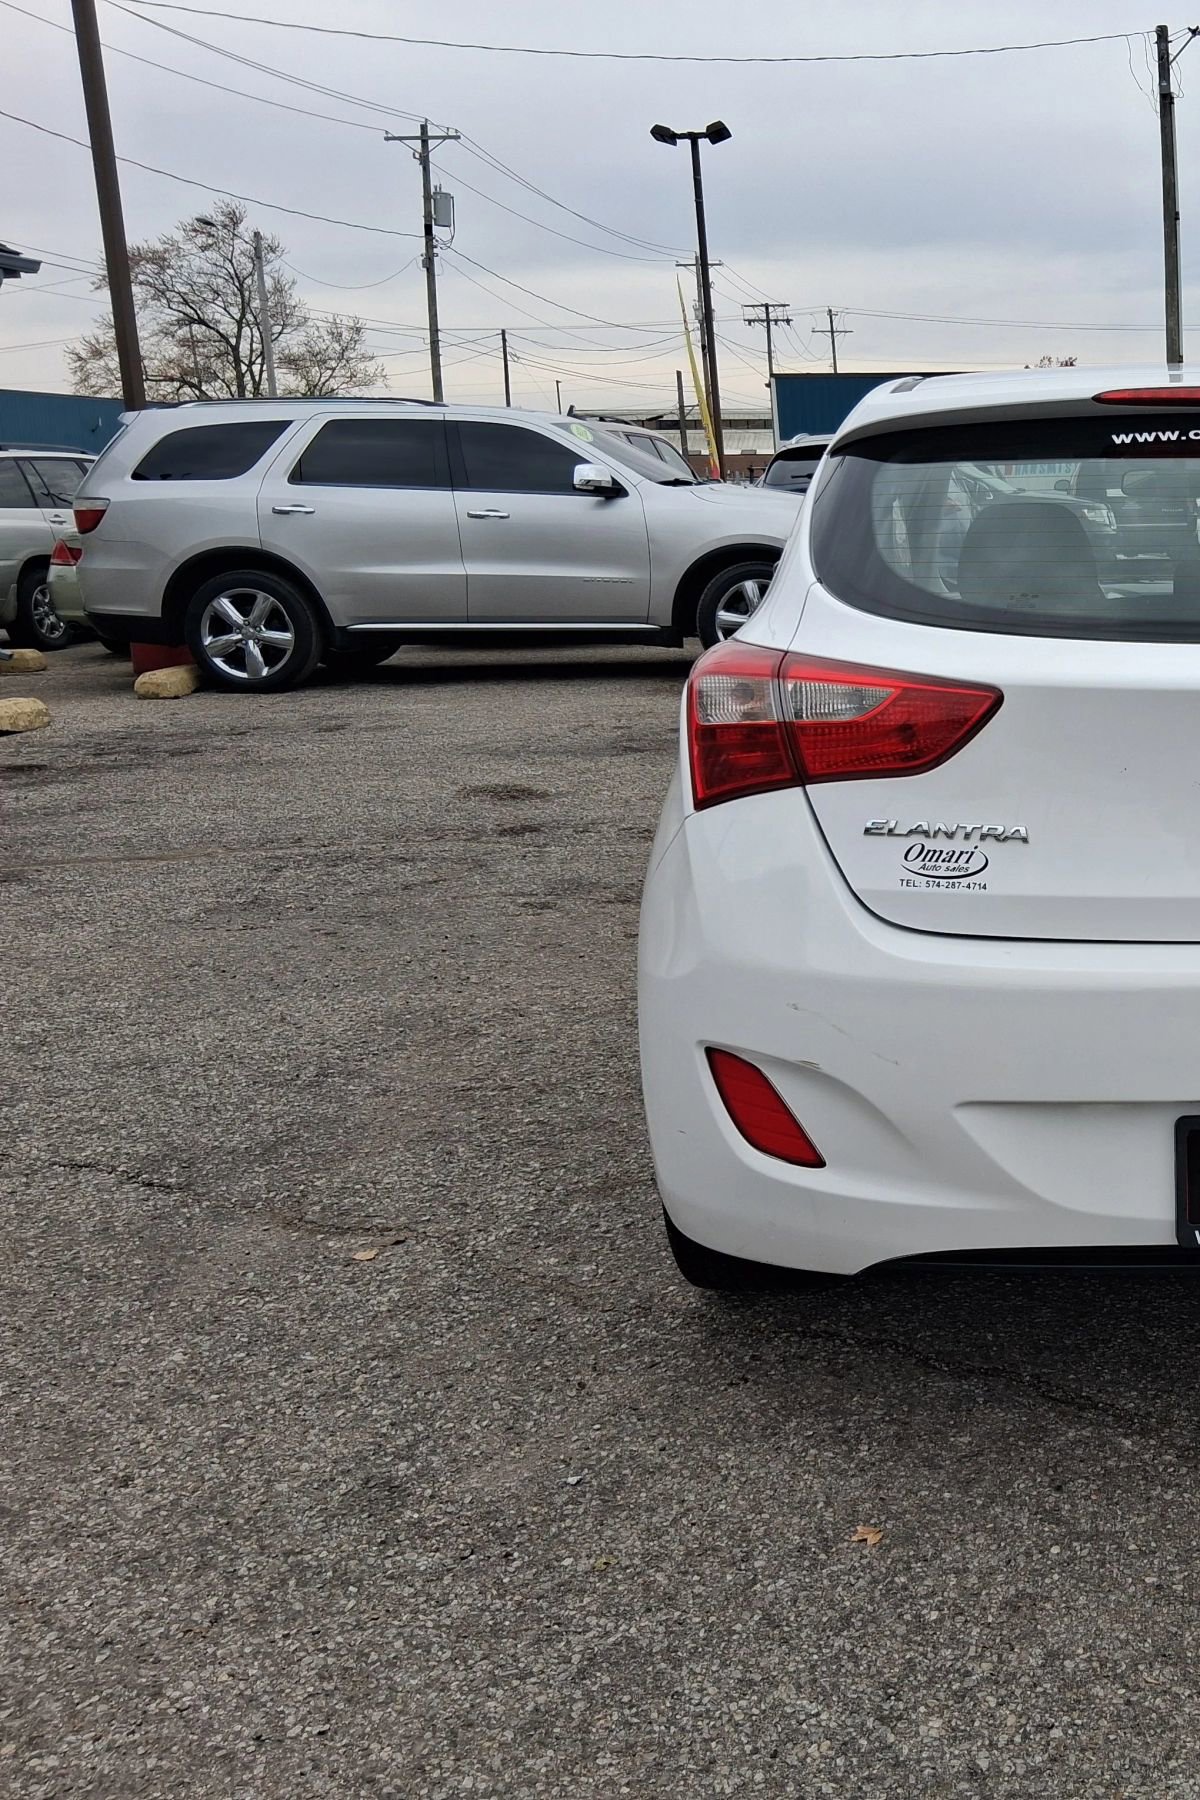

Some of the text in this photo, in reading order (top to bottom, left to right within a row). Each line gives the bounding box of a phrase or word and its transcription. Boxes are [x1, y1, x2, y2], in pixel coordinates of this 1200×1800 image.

[863, 818, 1029, 844] ELANTRA
[903, 843, 979, 864] Omari
[918, 863, 970, 873] Auto sales
[899, 879, 988, 891] TEL: 574-287-4714
